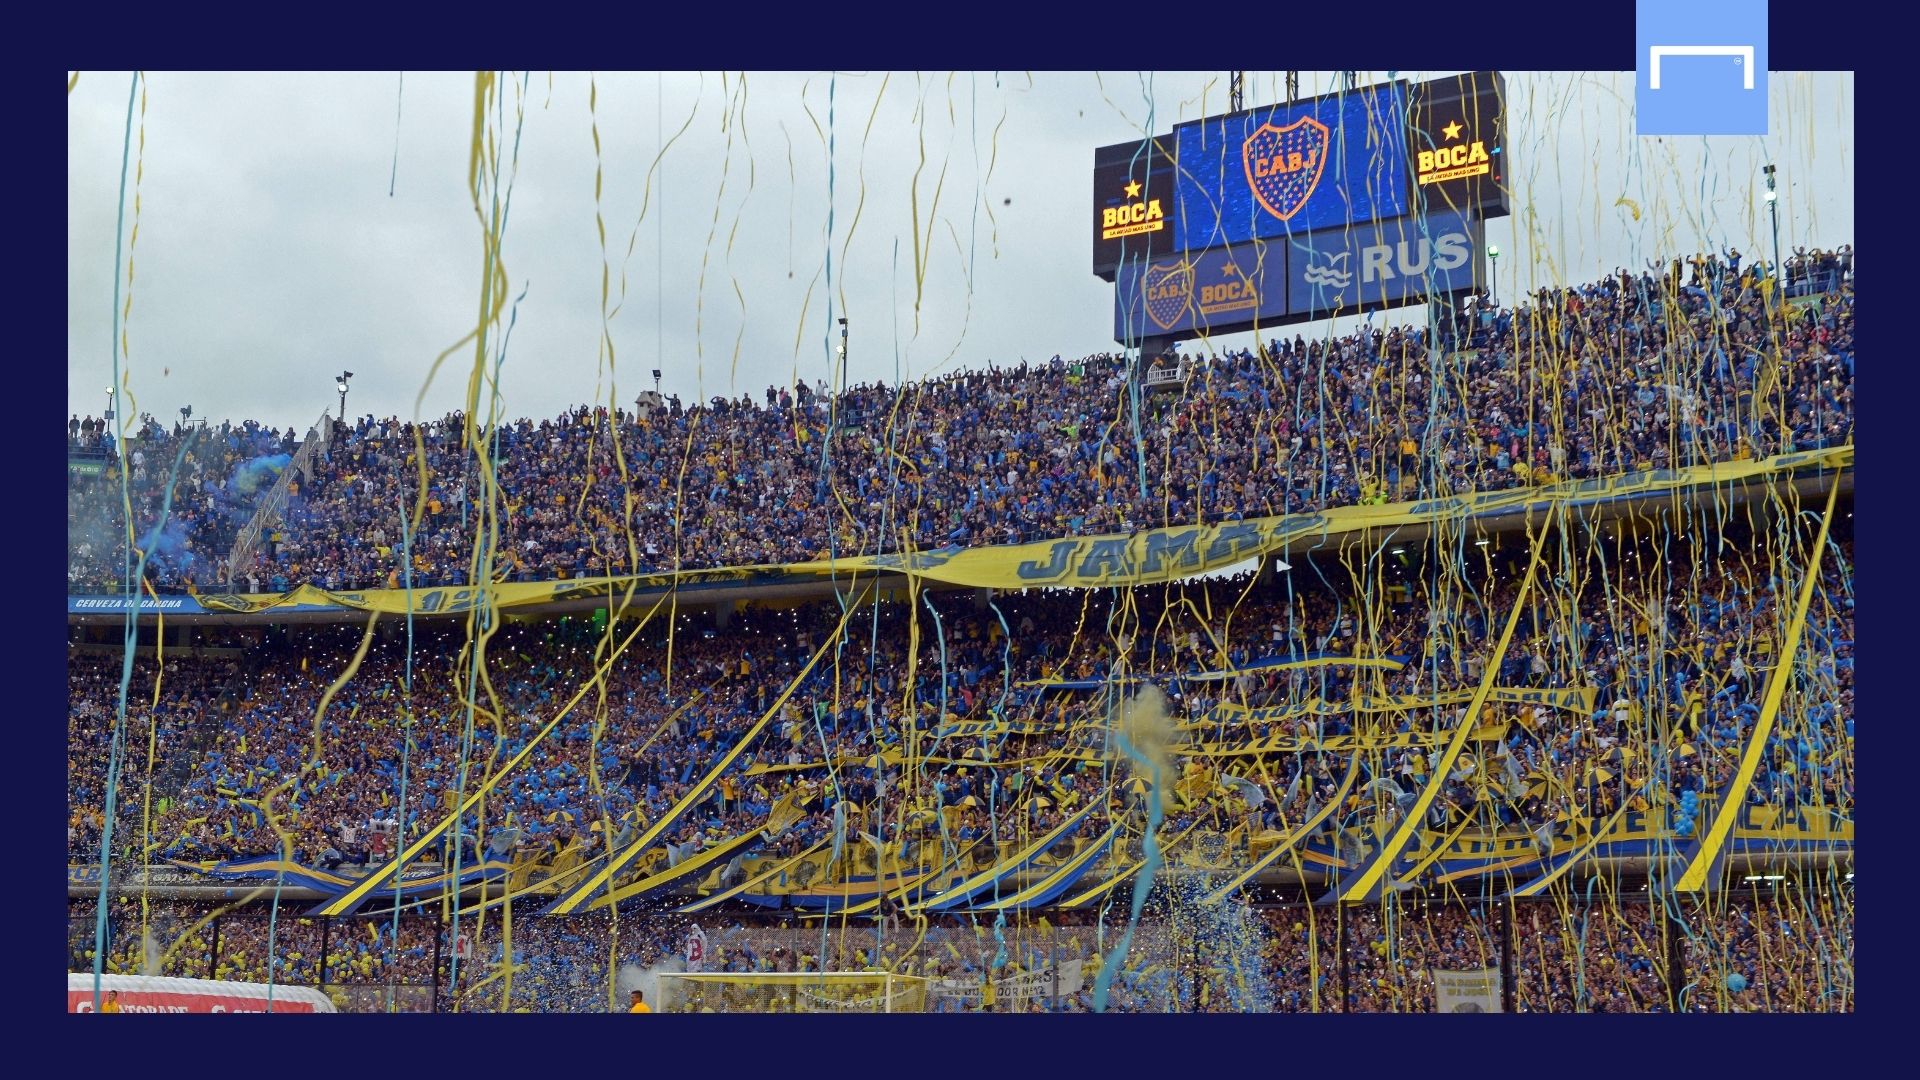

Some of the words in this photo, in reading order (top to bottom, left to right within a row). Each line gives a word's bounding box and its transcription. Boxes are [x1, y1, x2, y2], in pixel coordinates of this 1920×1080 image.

[1256, 149, 1316, 177] CABJ
[1418, 141, 1489, 172] BOCA
[1103, 199, 1163, 228] BOCA
[1362, 232, 1469, 283] RUS
[1148, 282, 1189, 301] CABJ
[1201, 281, 1256, 304] BOCA
[75, 599, 122, 608] CERVEZA
[140, 599, 183, 608] CANCHA
[689, 938, 703, 962] B
